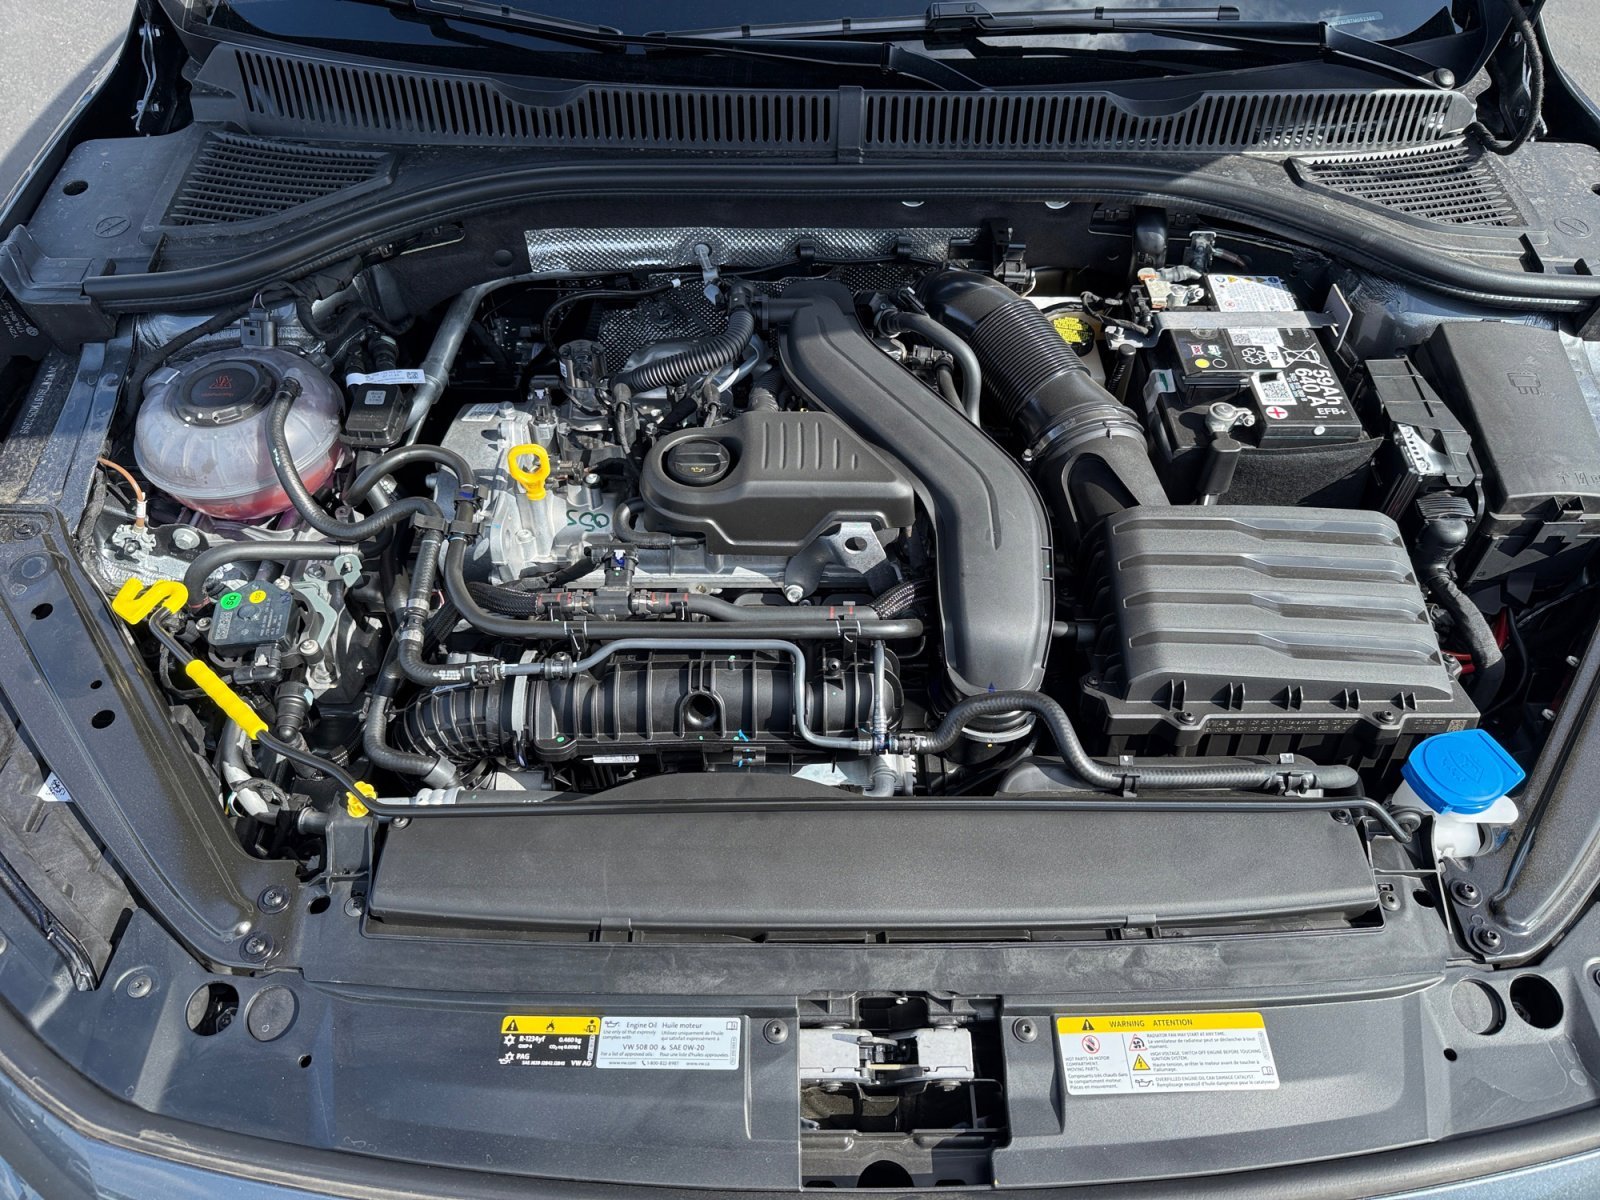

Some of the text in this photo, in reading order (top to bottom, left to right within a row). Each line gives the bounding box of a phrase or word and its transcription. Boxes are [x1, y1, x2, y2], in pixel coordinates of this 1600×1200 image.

[1295, 368, 1320, 392] 640
[1313, 369, 1344, 404] 59Ah
[1307, 396, 1327, 406] A
